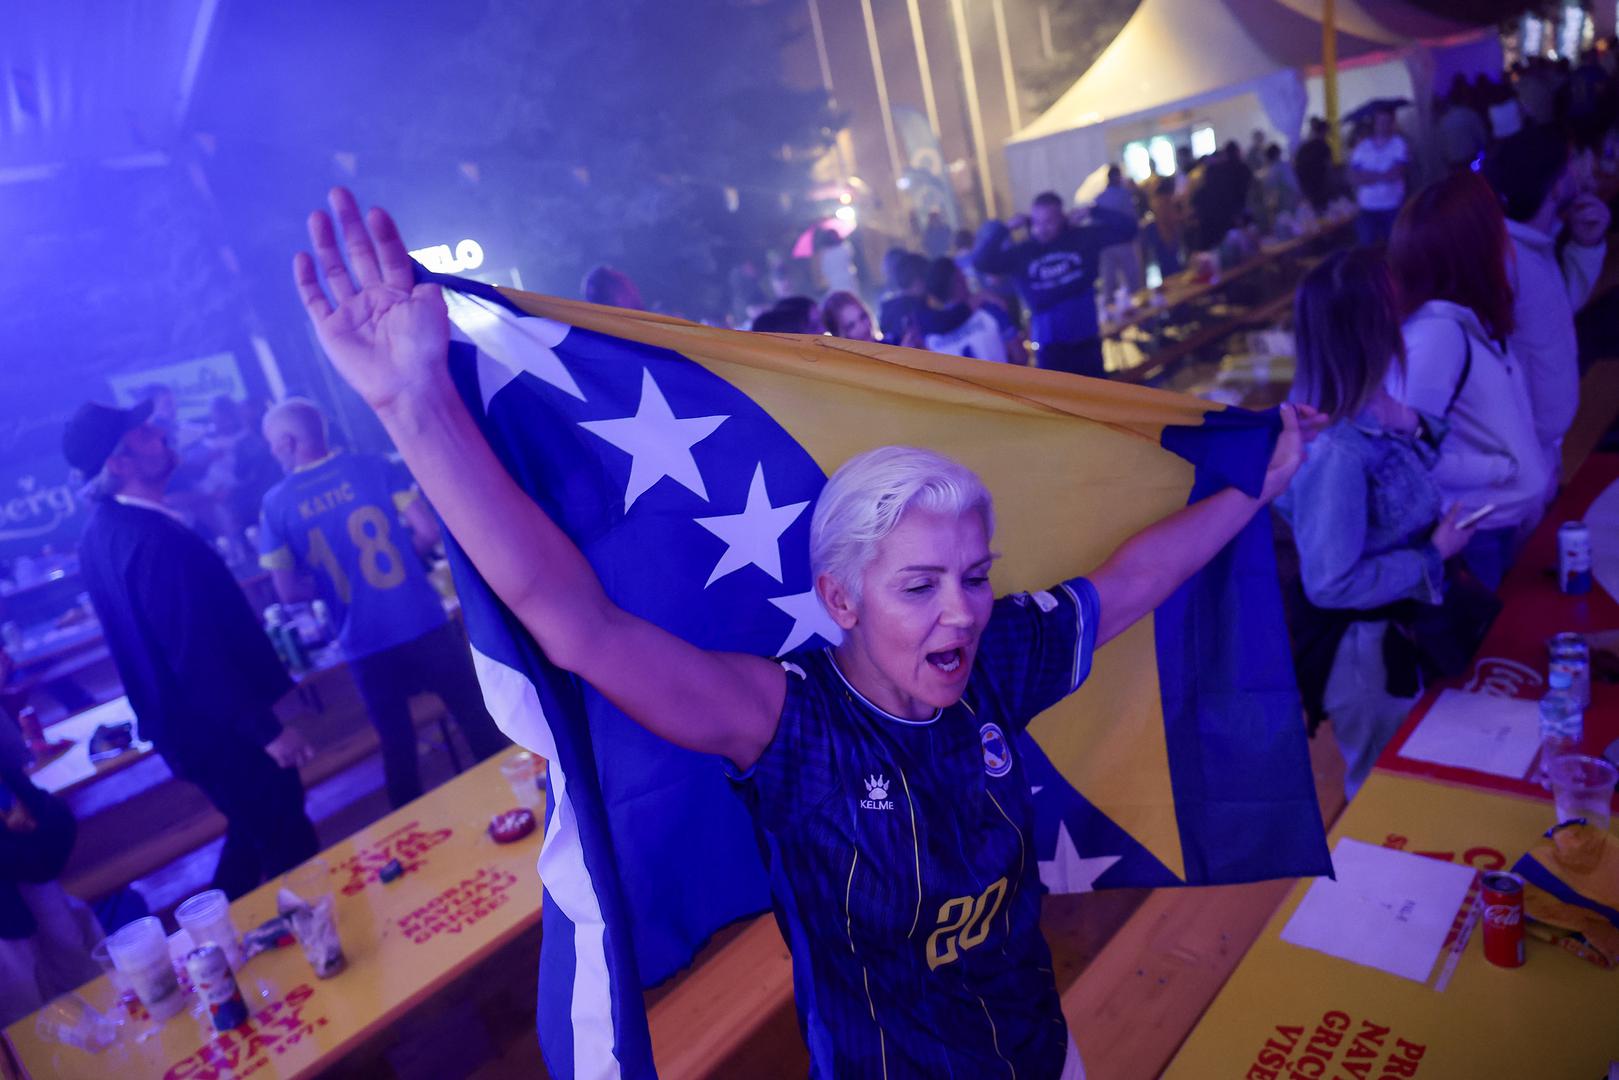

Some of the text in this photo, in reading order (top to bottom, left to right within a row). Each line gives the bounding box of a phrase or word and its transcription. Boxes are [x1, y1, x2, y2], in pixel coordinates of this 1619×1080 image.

[306, 504, 406, 604] 18
[860, 799, 895, 810] KELME
[926, 876, 1008, 973] 20
